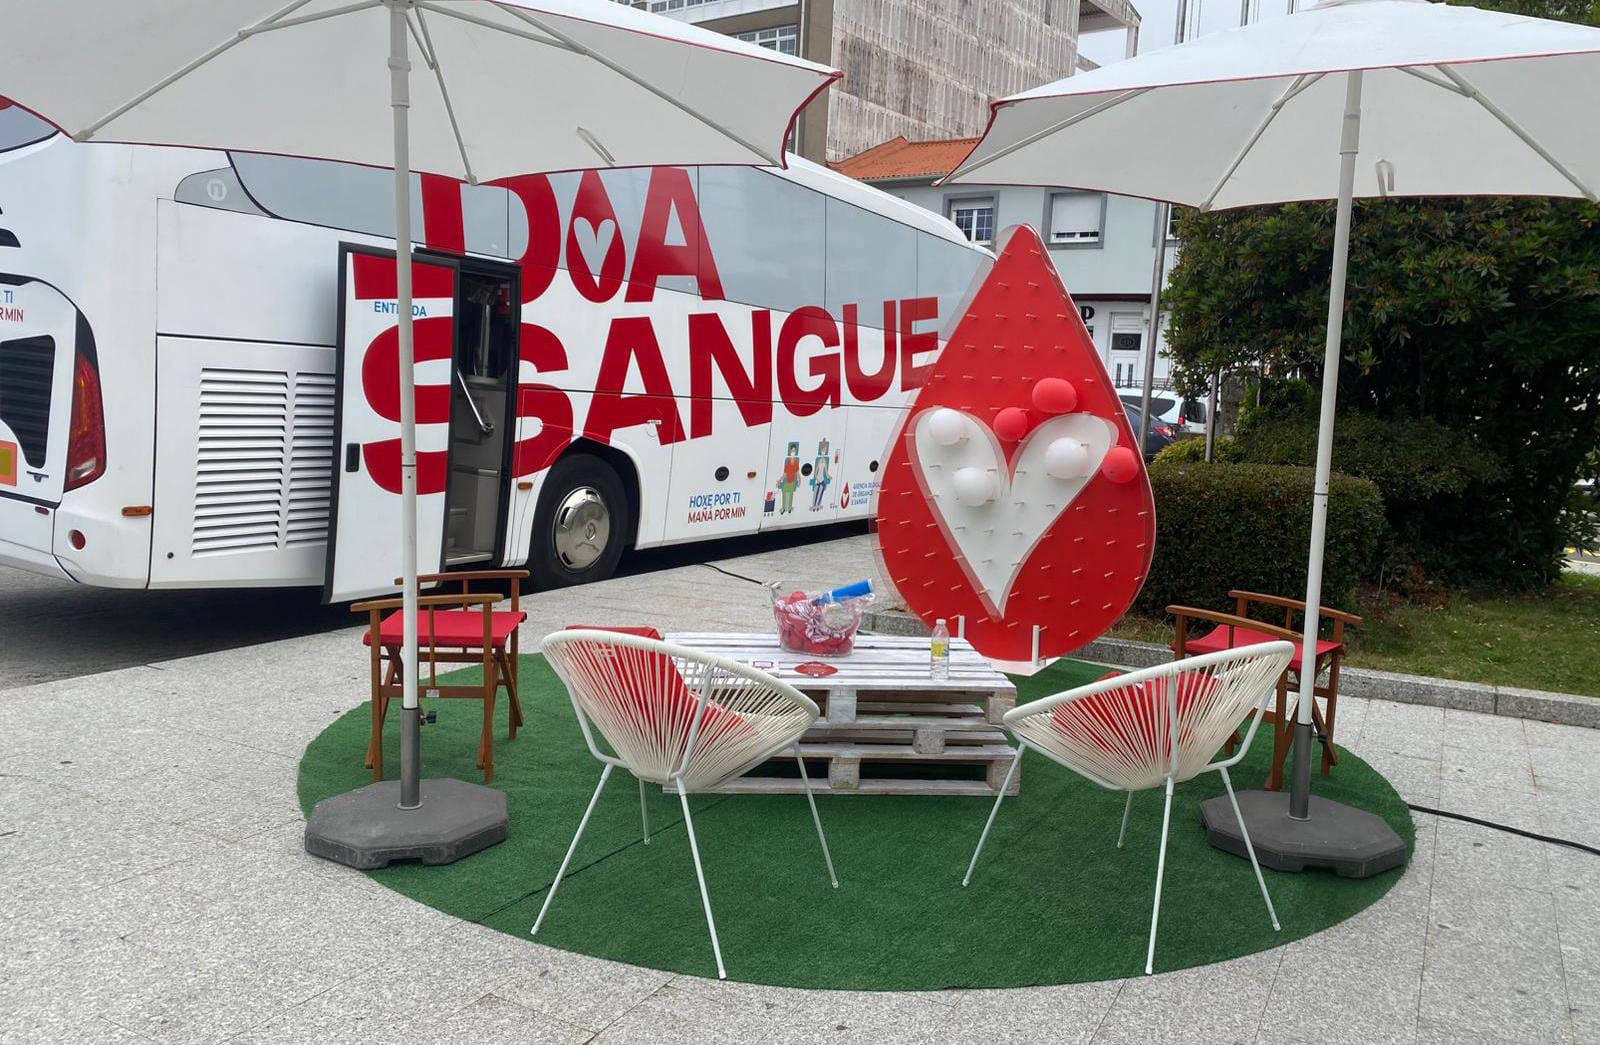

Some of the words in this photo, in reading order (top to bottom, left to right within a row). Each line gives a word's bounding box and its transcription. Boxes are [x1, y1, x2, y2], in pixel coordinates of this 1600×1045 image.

[3, 290, 13, 304] TI
[5, 308, 24, 322] MIN
[374, 301, 427, 317] ENTDA
[362, 296, 939, 495] SANGUE
[689, 494, 713, 508] HOXE
[714, 493, 731, 506] POR
[733, 491, 741, 503] TI
[714, 508, 731, 521] POR
[731, 506, 746, 519] MIN
